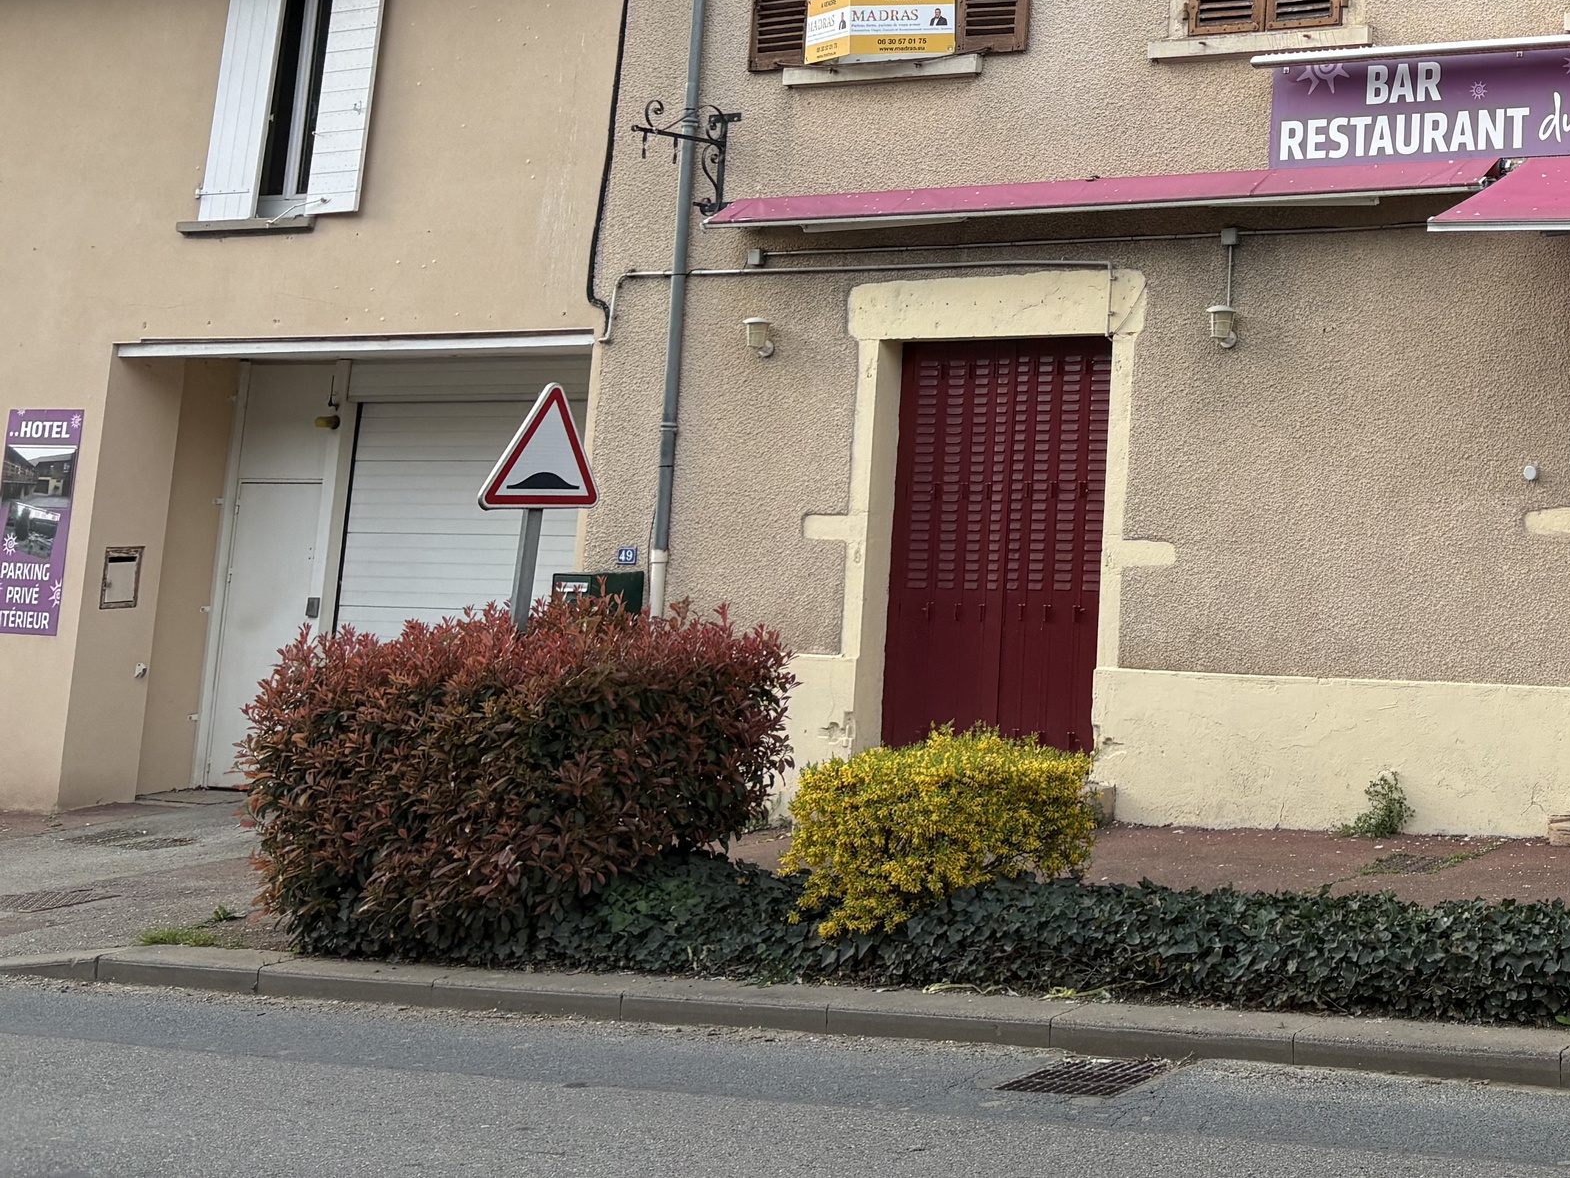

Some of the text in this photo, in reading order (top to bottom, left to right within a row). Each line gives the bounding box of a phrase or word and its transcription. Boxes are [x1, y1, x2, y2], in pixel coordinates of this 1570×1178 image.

[851, 8, 919, 22] MADRAS
[1364, 60, 1442, 106] BAR
[1279, 106, 1530, 162] RESTAURANT
[618, 550, 633, 561] 49
[0, 562, 50, 581] PARKING
[6, 584, 40, 604] PRIVÉ
[0, 606, 50, 629] TÉRIEUR
